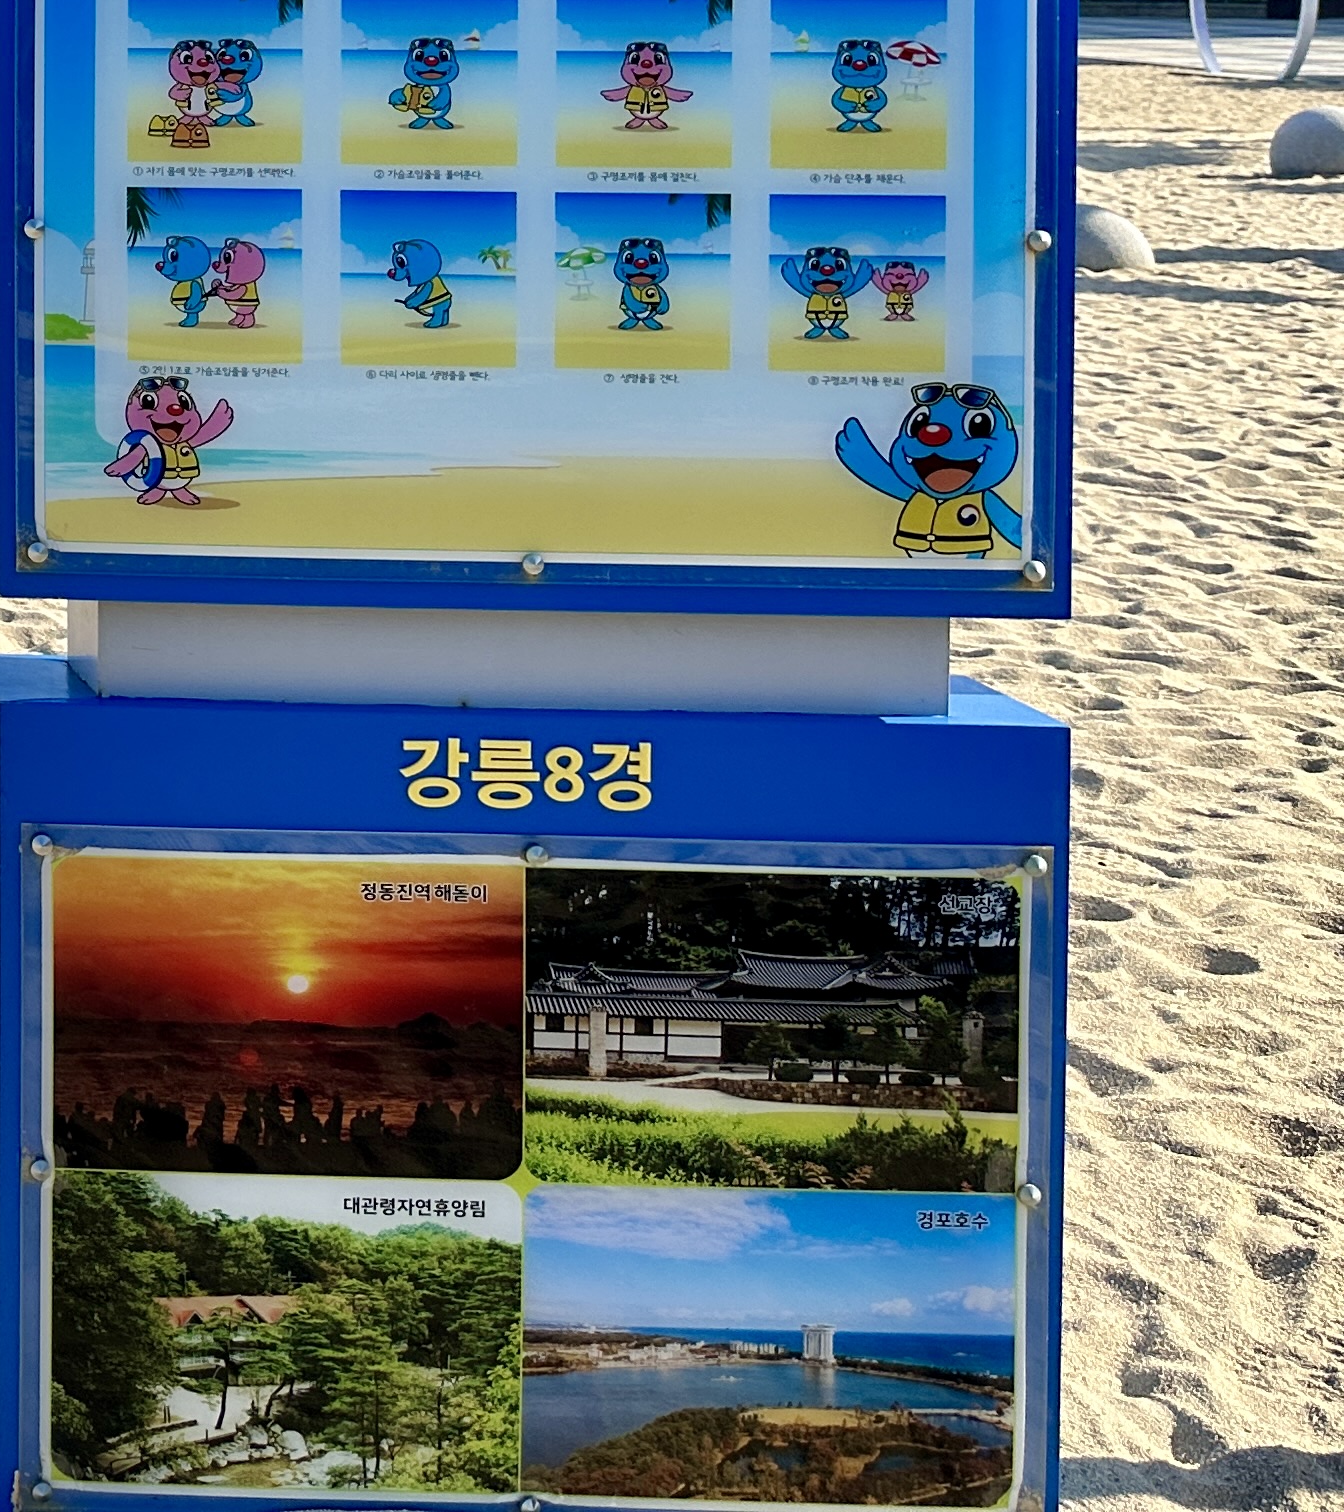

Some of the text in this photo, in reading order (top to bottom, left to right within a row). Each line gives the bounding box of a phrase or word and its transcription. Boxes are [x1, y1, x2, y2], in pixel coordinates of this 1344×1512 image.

[400, 736, 653, 812] 강릉8경
[938, 894, 993, 915] 선교장
[343, 1196, 486, 1218] 대관령자연휴양림
[917, 1210, 990, 1231] 경포호수
